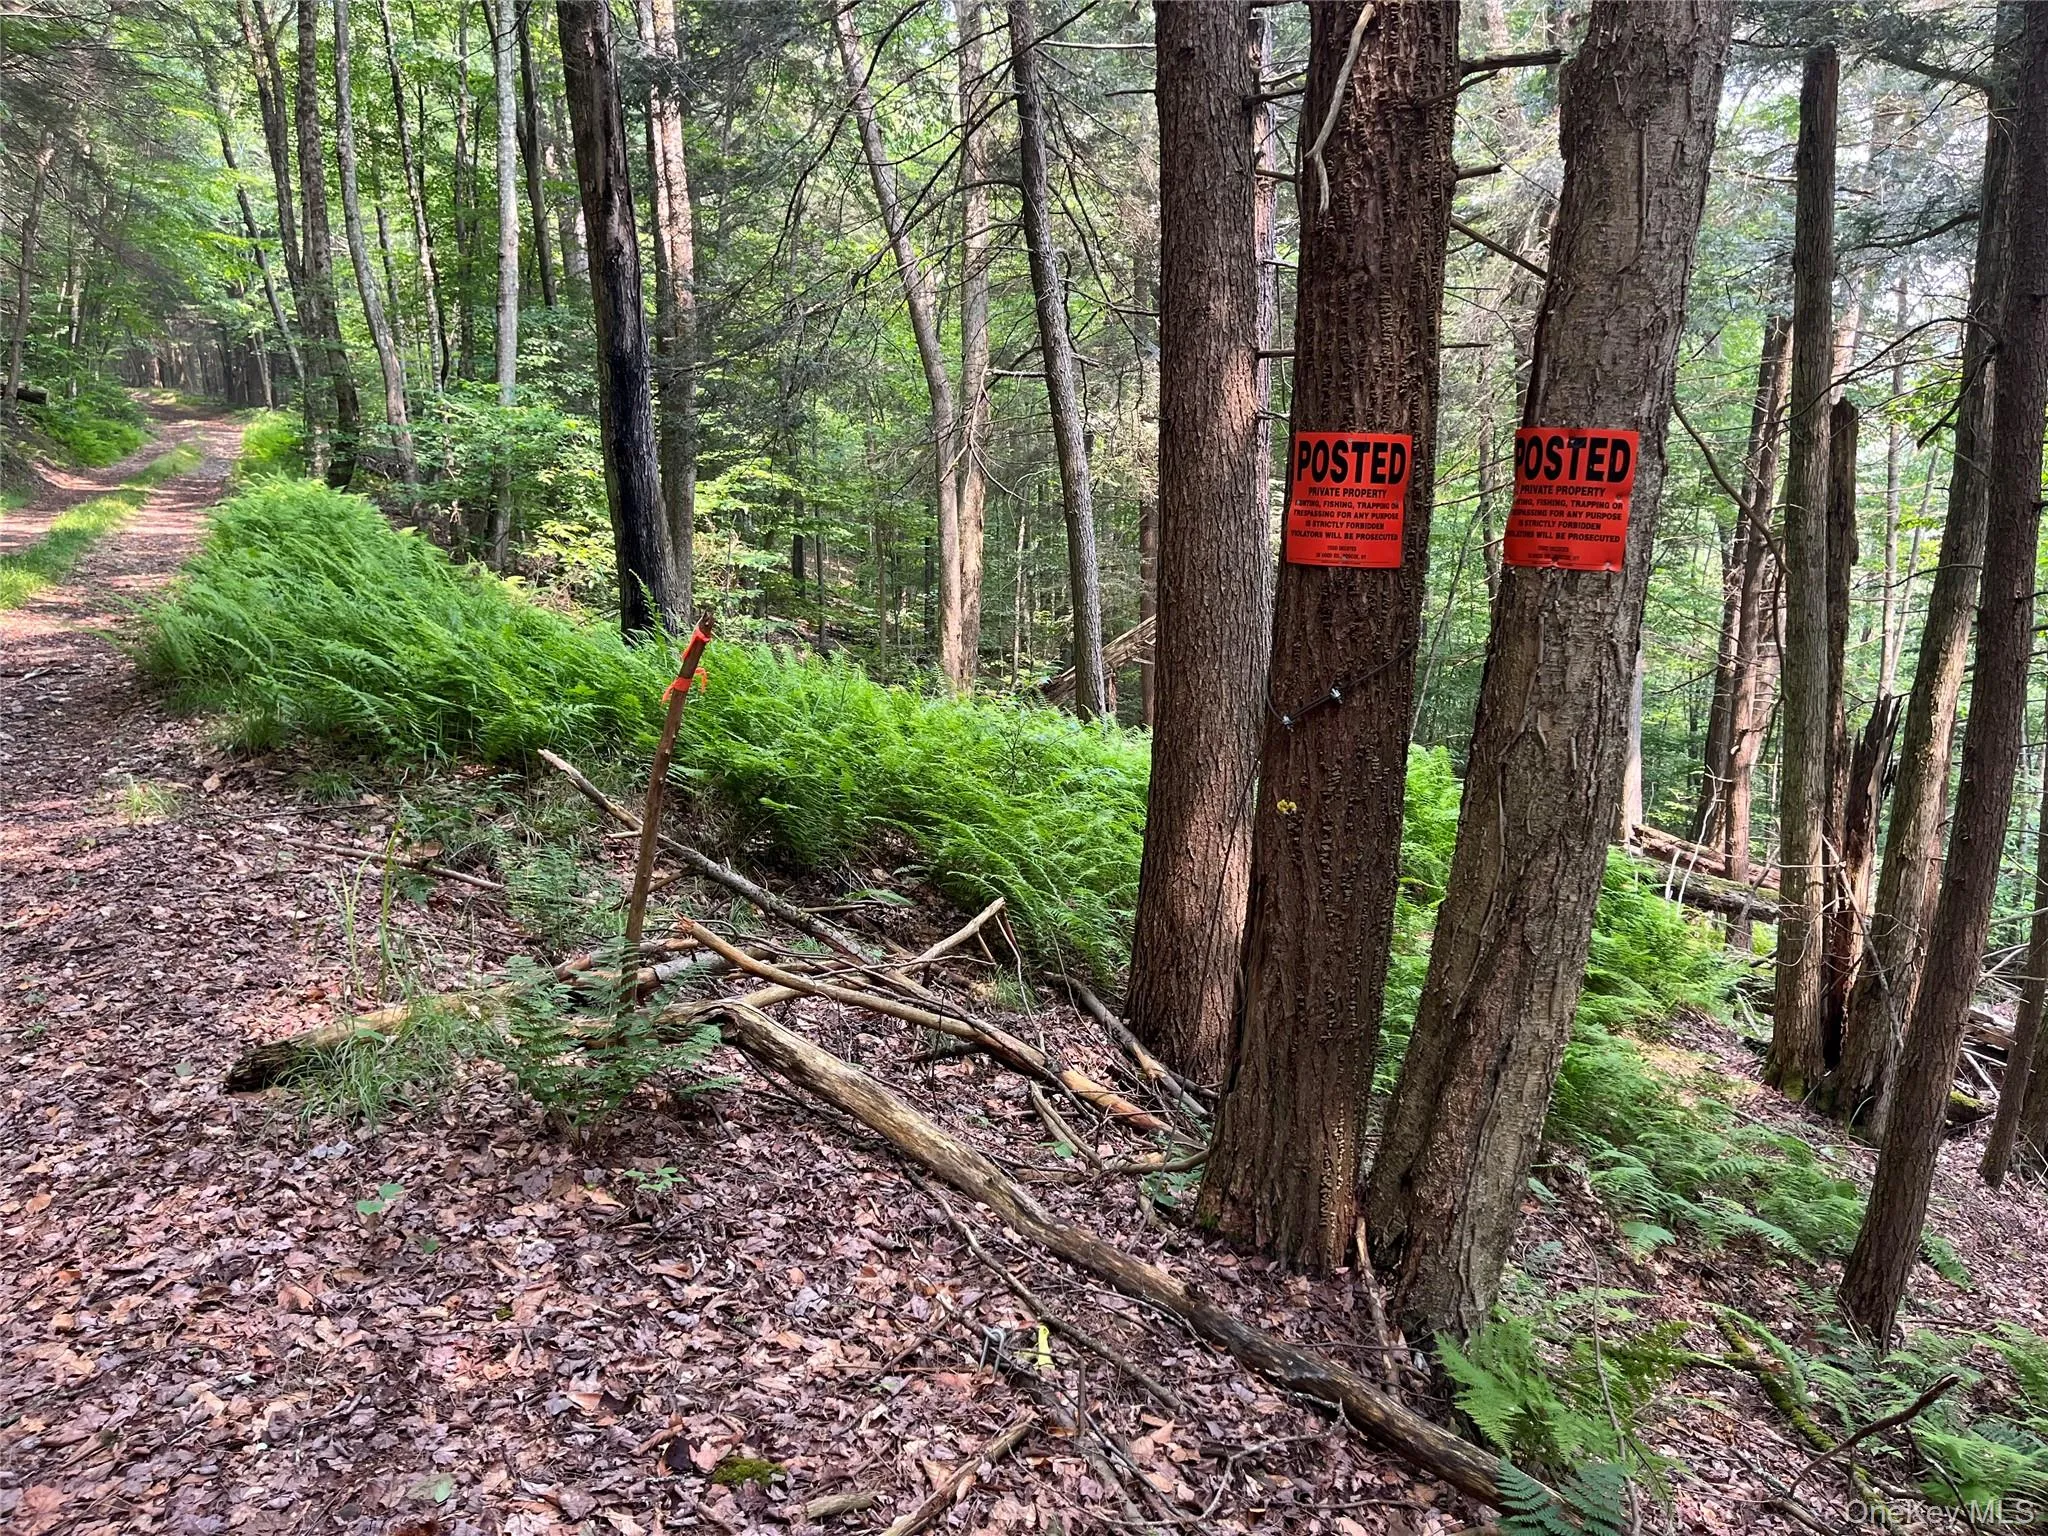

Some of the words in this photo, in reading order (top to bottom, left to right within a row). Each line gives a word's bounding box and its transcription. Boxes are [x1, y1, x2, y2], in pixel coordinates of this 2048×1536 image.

[1297, 439, 1406, 485] POSTED
[1516, 435, 1631, 483] POSTED
[1308, 487, 1340, 497] PRIVATE
[1343, 488, 1388, 498] PROPERTY
[1520, 485, 1553, 494] PRIVATE
[1556, 486, 1606, 497] PROPERTY
[1323, 501, 1354, 510] FISHING,
[1536, 500, 1568, 508] FISHING,
[1571, 500, 1610, 509] TRAPPING
[1612, 502, 1623, 510] OR
[1294, 510, 1334, 518] TRESPASSING
[1354, 512, 1369, 520] ANY
[1550, 510, 1564, 518] FOR
[1567, 511, 1584, 519] ANY
[1585, 512, 1622, 520] PURPOSE
[1312, 520, 1344, 528] STRICTLY
[1346, 522, 1384, 530] FORBIDDEN
[1524, 520, 1556, 528] STRICTLY
[1558, 521, 1602, 530] FORBIDDEN
[1291, 529, 1323, 538] VIOLATORS
[1325, 531, 1342, 539] WILL
[1344, 532, 1354, 540] BE
[1356, 532, 1398, 540] PROSECUTED
[1536, 531, 1553, 539] WILL
[1556, 532, 1566, 540] BE
[1568, 532, 1621, 543] PROSECUTED
